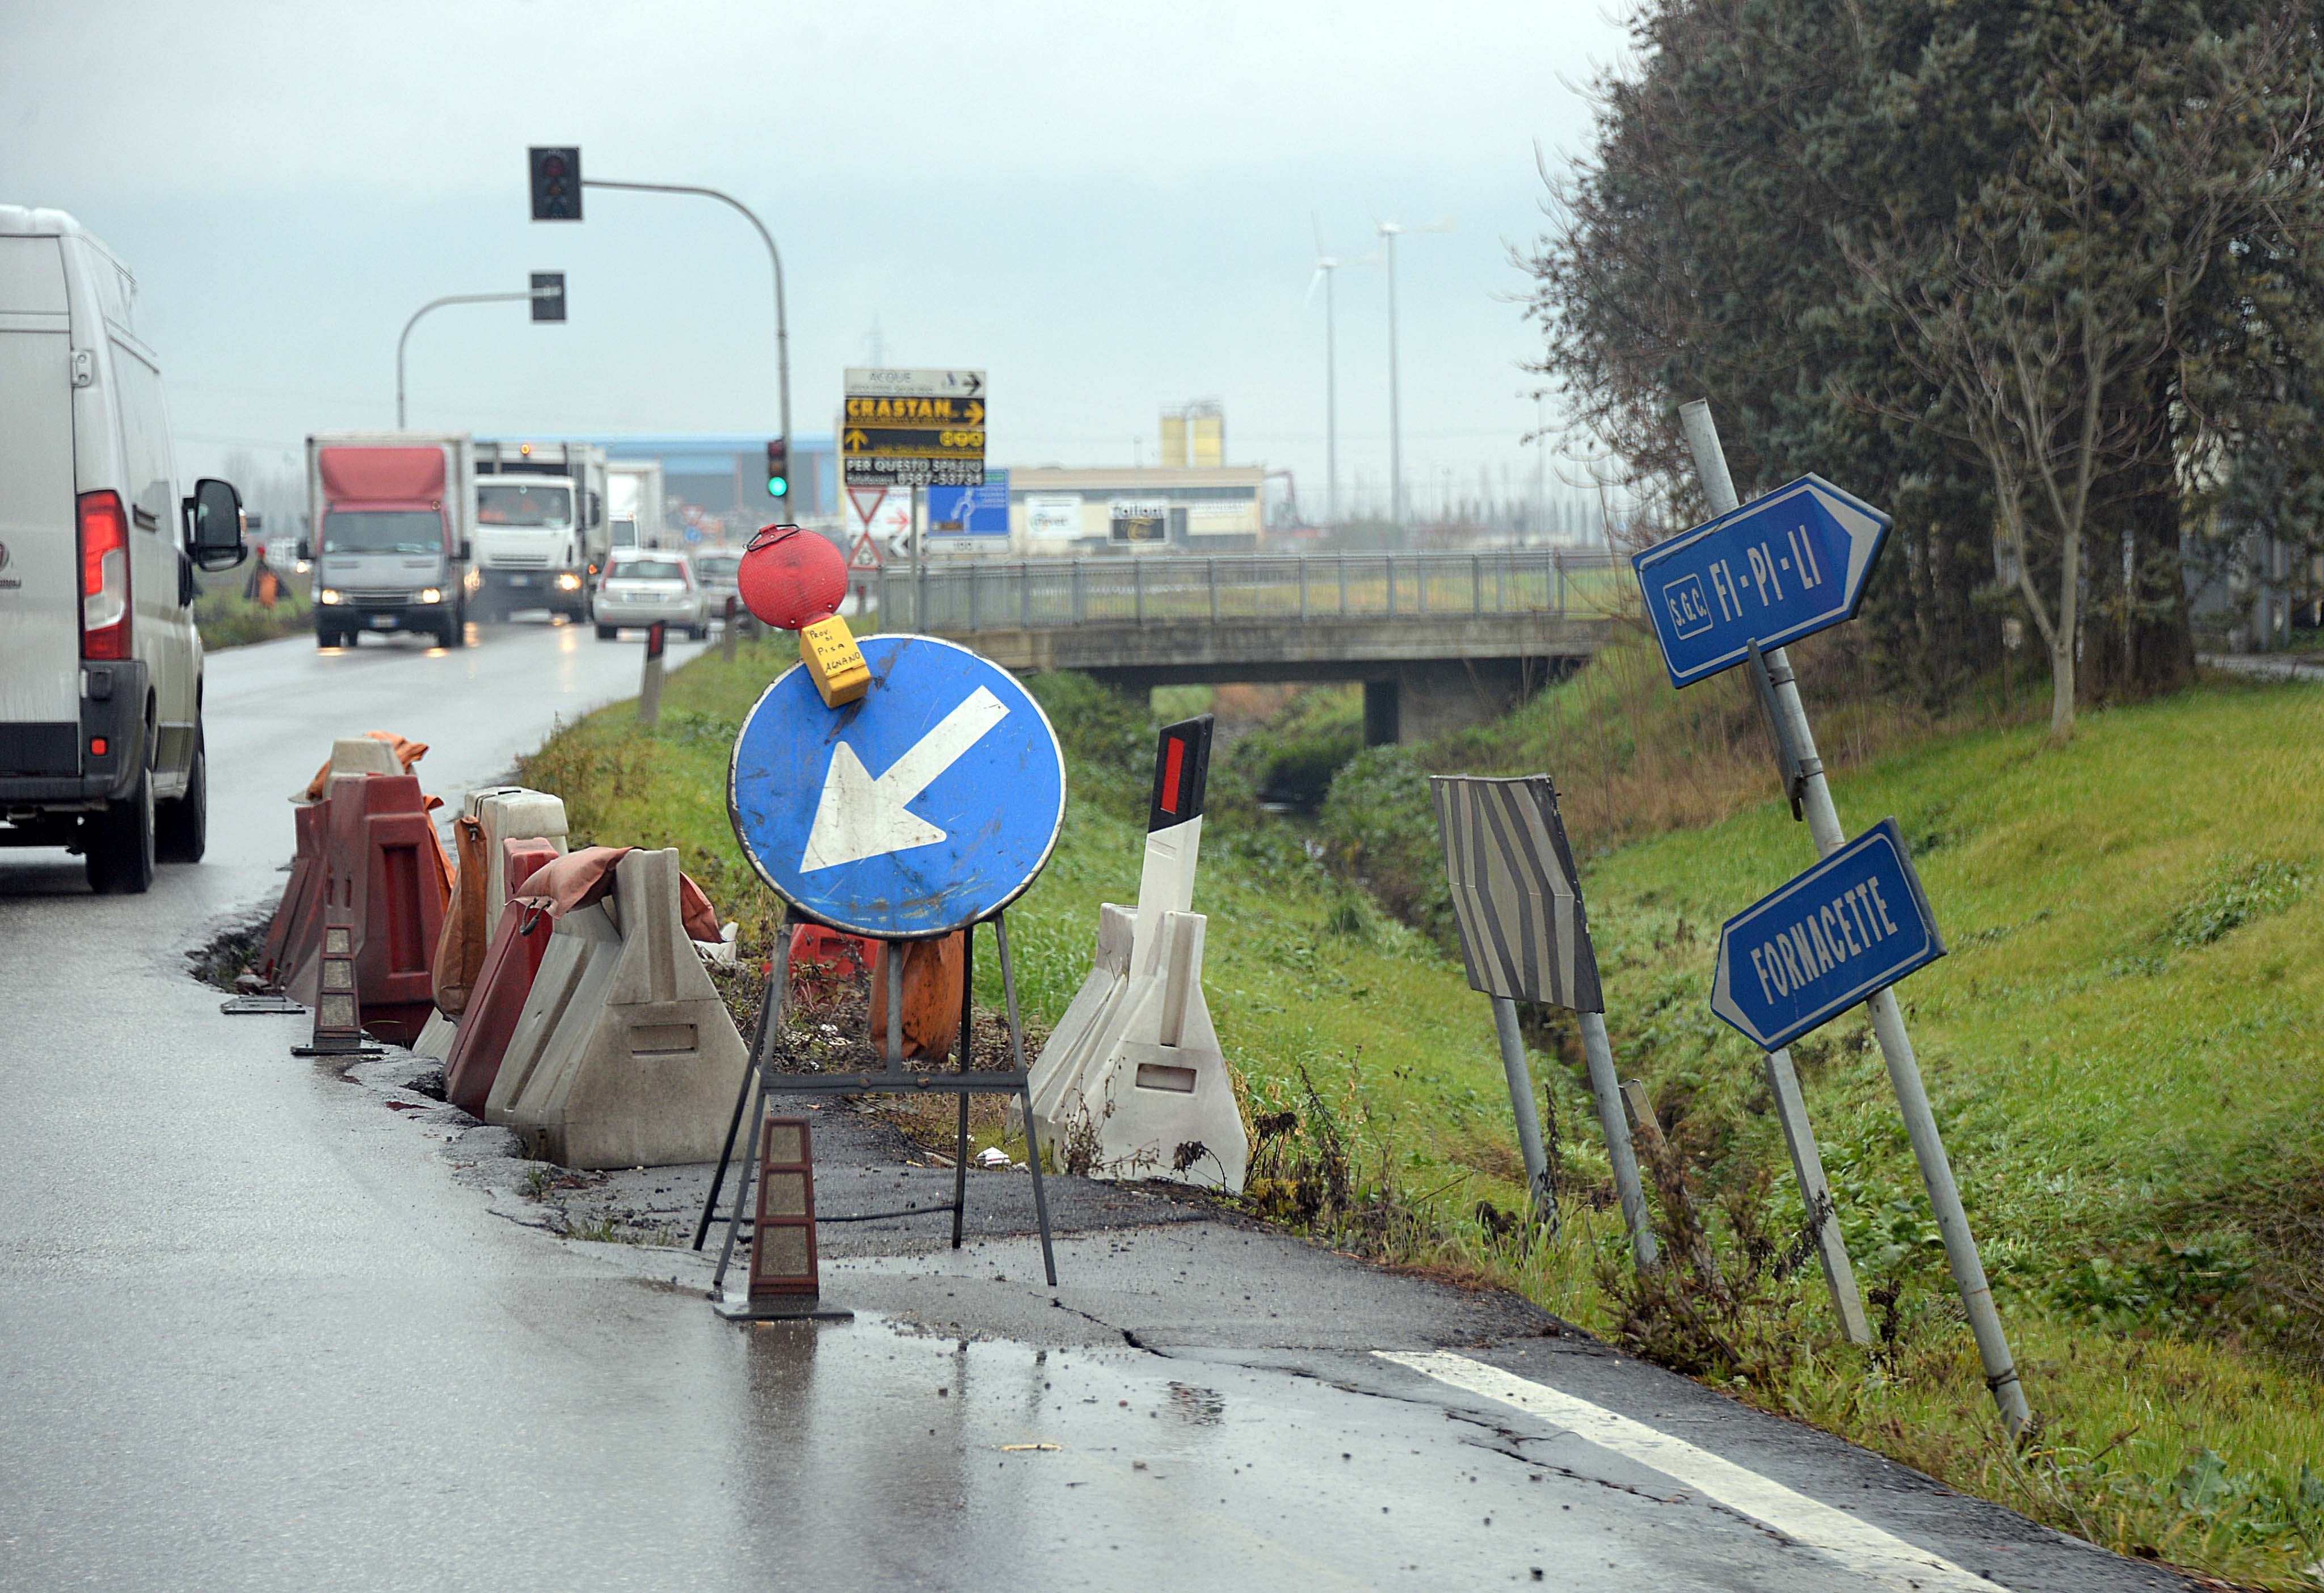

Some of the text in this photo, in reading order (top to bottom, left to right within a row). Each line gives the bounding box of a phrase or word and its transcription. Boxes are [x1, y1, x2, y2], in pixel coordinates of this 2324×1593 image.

[870, 372, 911, 383] ACQUE
[847, 398, 952, 418] CRASTAN
[847, 458, 982, 472] PER QUESTO SPAZIO
[1670, 587, 1707, 626] S.G.C.
[826, 652, 860, 672] AGNANO
[1750, 876, 1898, 1005] FORNACETTE
